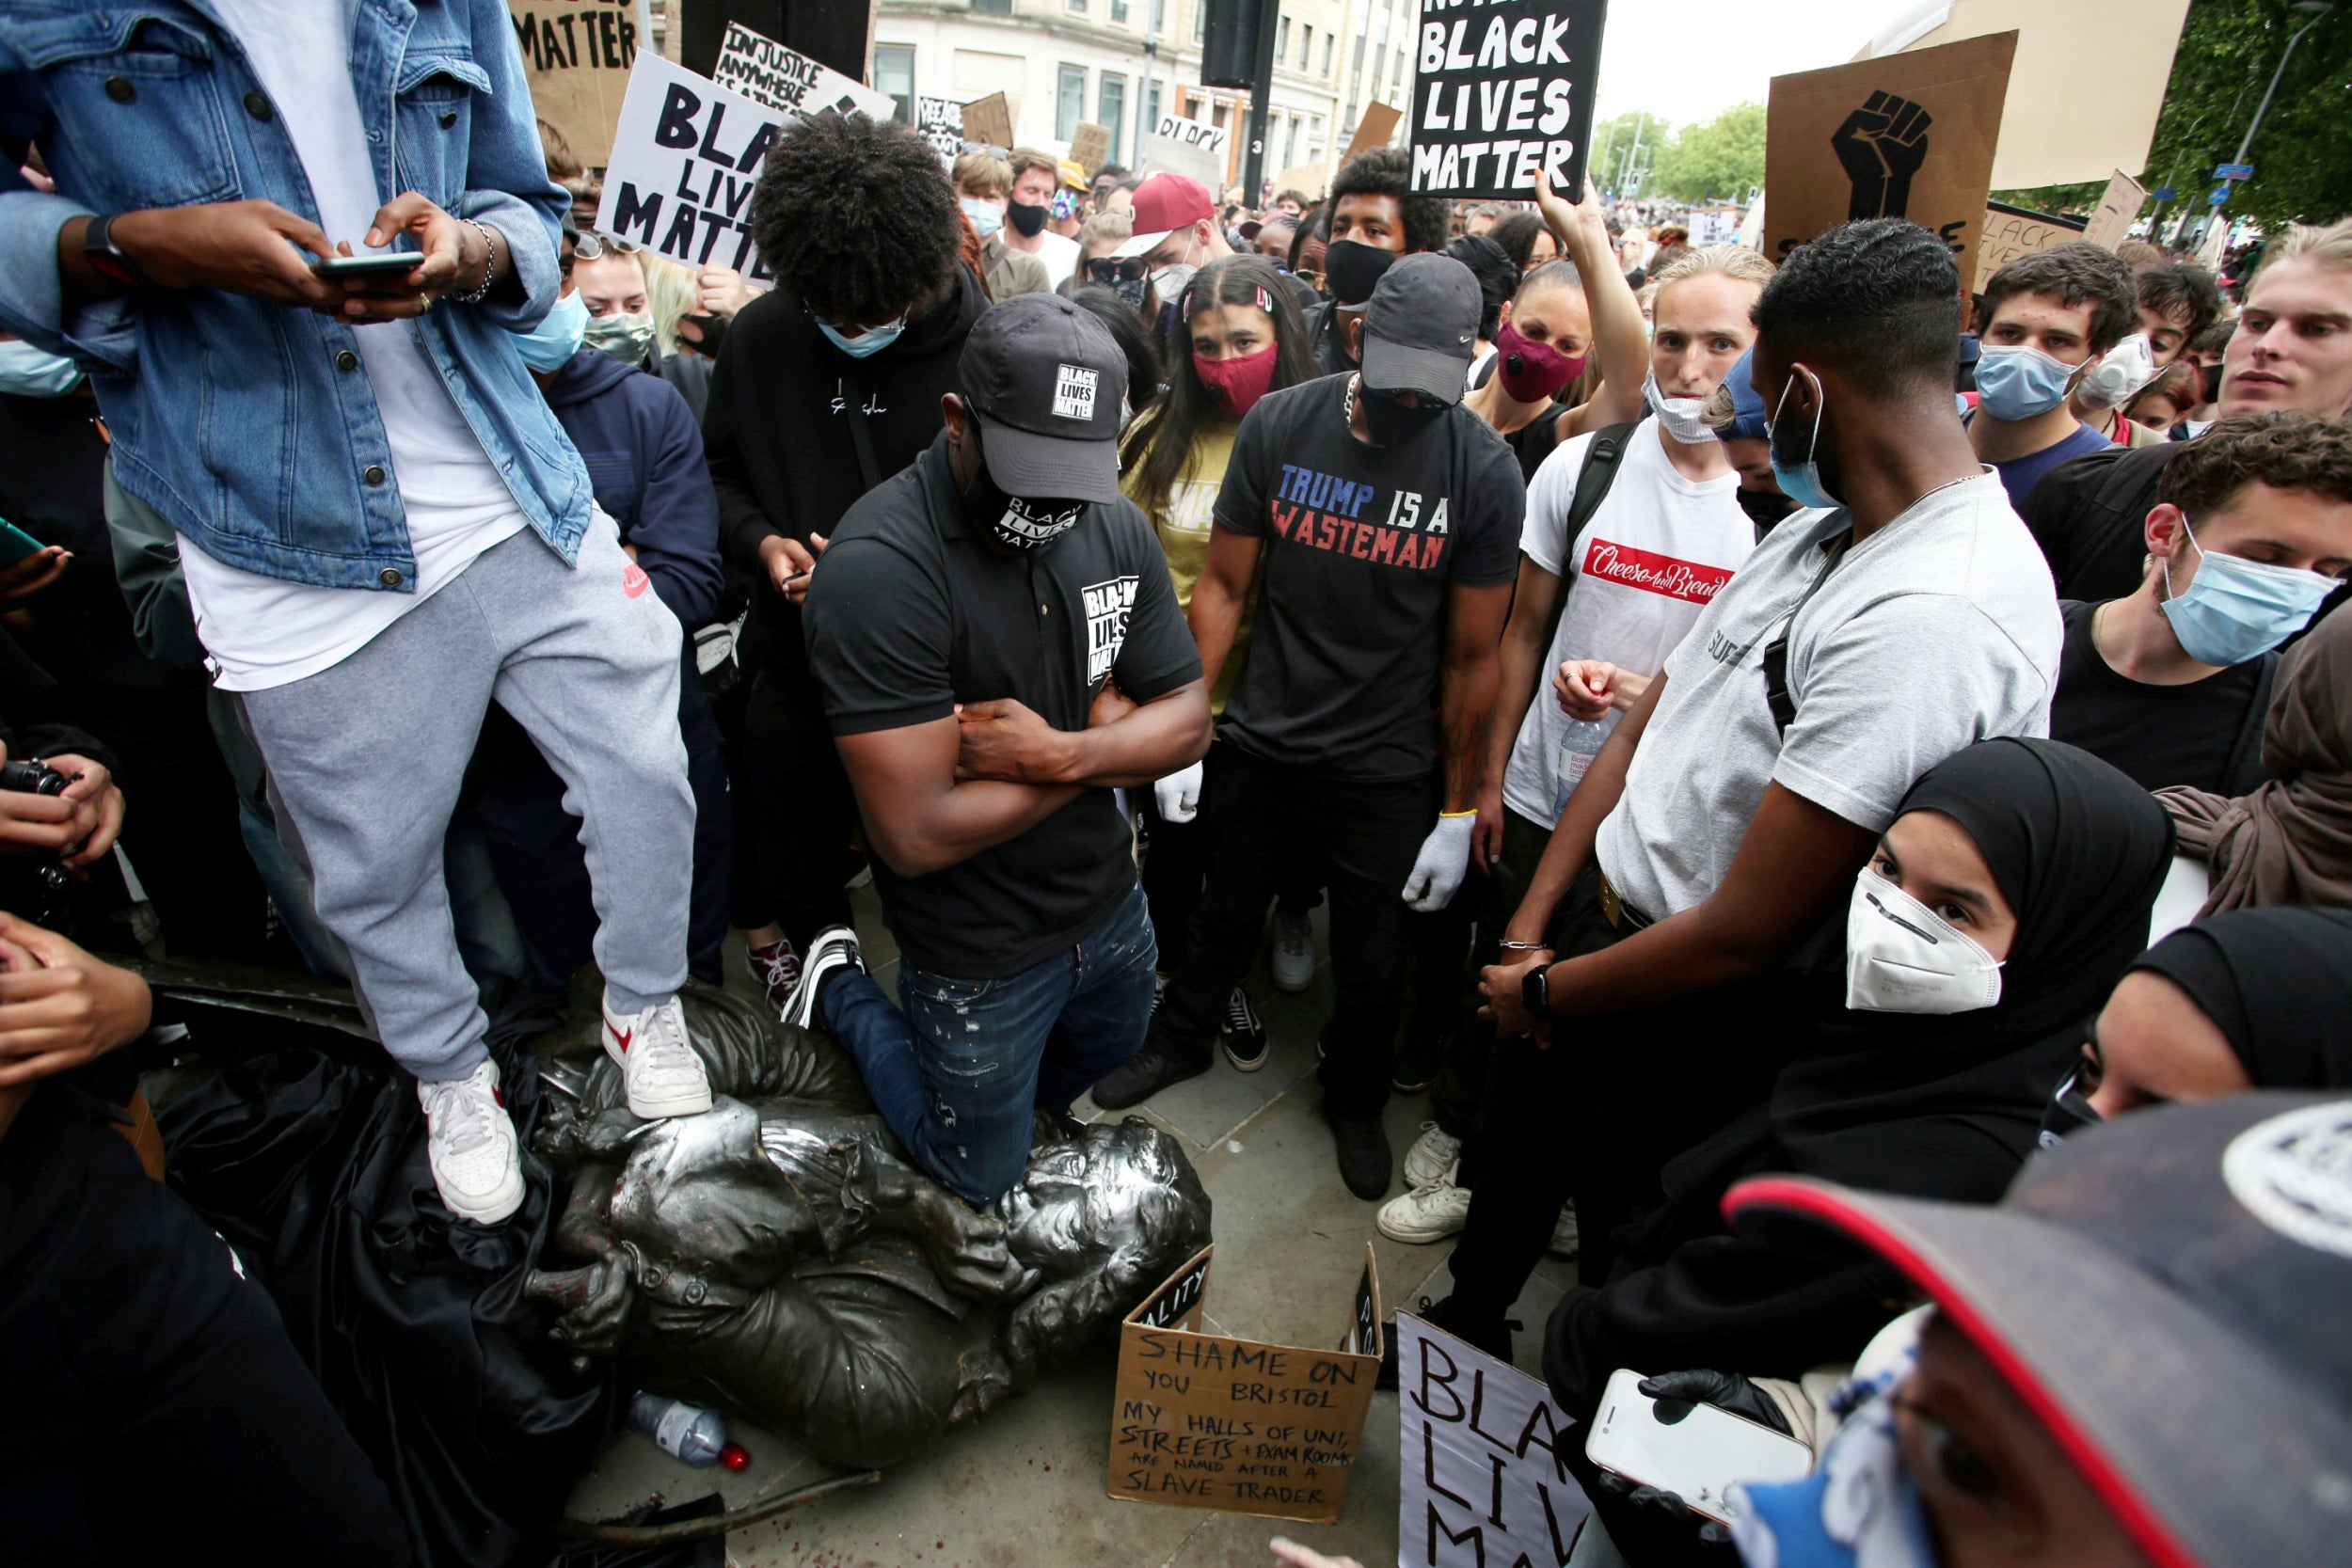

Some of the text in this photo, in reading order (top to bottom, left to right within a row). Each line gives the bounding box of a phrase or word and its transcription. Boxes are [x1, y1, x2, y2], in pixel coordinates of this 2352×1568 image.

[511, 11, 636, 71] MATTER
[725, 27, 823, 89] INJUSTICE
[1419, 13, 1571, 73] BLACK
[719, 54, 807, 107] ANYWHERE
[1422, 77, 1572, 135] LIVES
[654, 83, 781, 174] BLA
[1251, 140, 1263, 154] 3
[676, 159, 755, 223] LIV
[1411, 139, 1573, 191] MATTER
[612, 182, 774, 280] MATT
[1983, 213, 2056, 249] LACK
[1059, 367, 1097, 386] BLACK
[1060, 383, 1091, 402] LIVES
[1054, 399, 1092, 419] MATTER
[1278, 464, 1449, 534] TRUMP IS A
[1271, 499, 1446, 569] WASTEMAN
[1139, 1265, 1206, 1326] ALITY
[1138, 1334, 1358, 1386] SHAME ON
[1144, 1370, 1337, 1409] YOU BRISTOL
[1409, 1336, 1567, 1485] BLA
[1119, 1425, 1236, 1460] STREETS
[1256, 1442, 1297, 1463] EXAM
[1303, 1446, 1353, 1466] ROOMS
[1123, 1401, 1348, 1449] MY HALLS OF UNI,
[1122, 1469, 1325, 1503] SLAVE TRADER
[1132, 1452, 1319, 1481] ARE NAMED AFTER A
[1422, 1419, 1591, 1568] LIV
